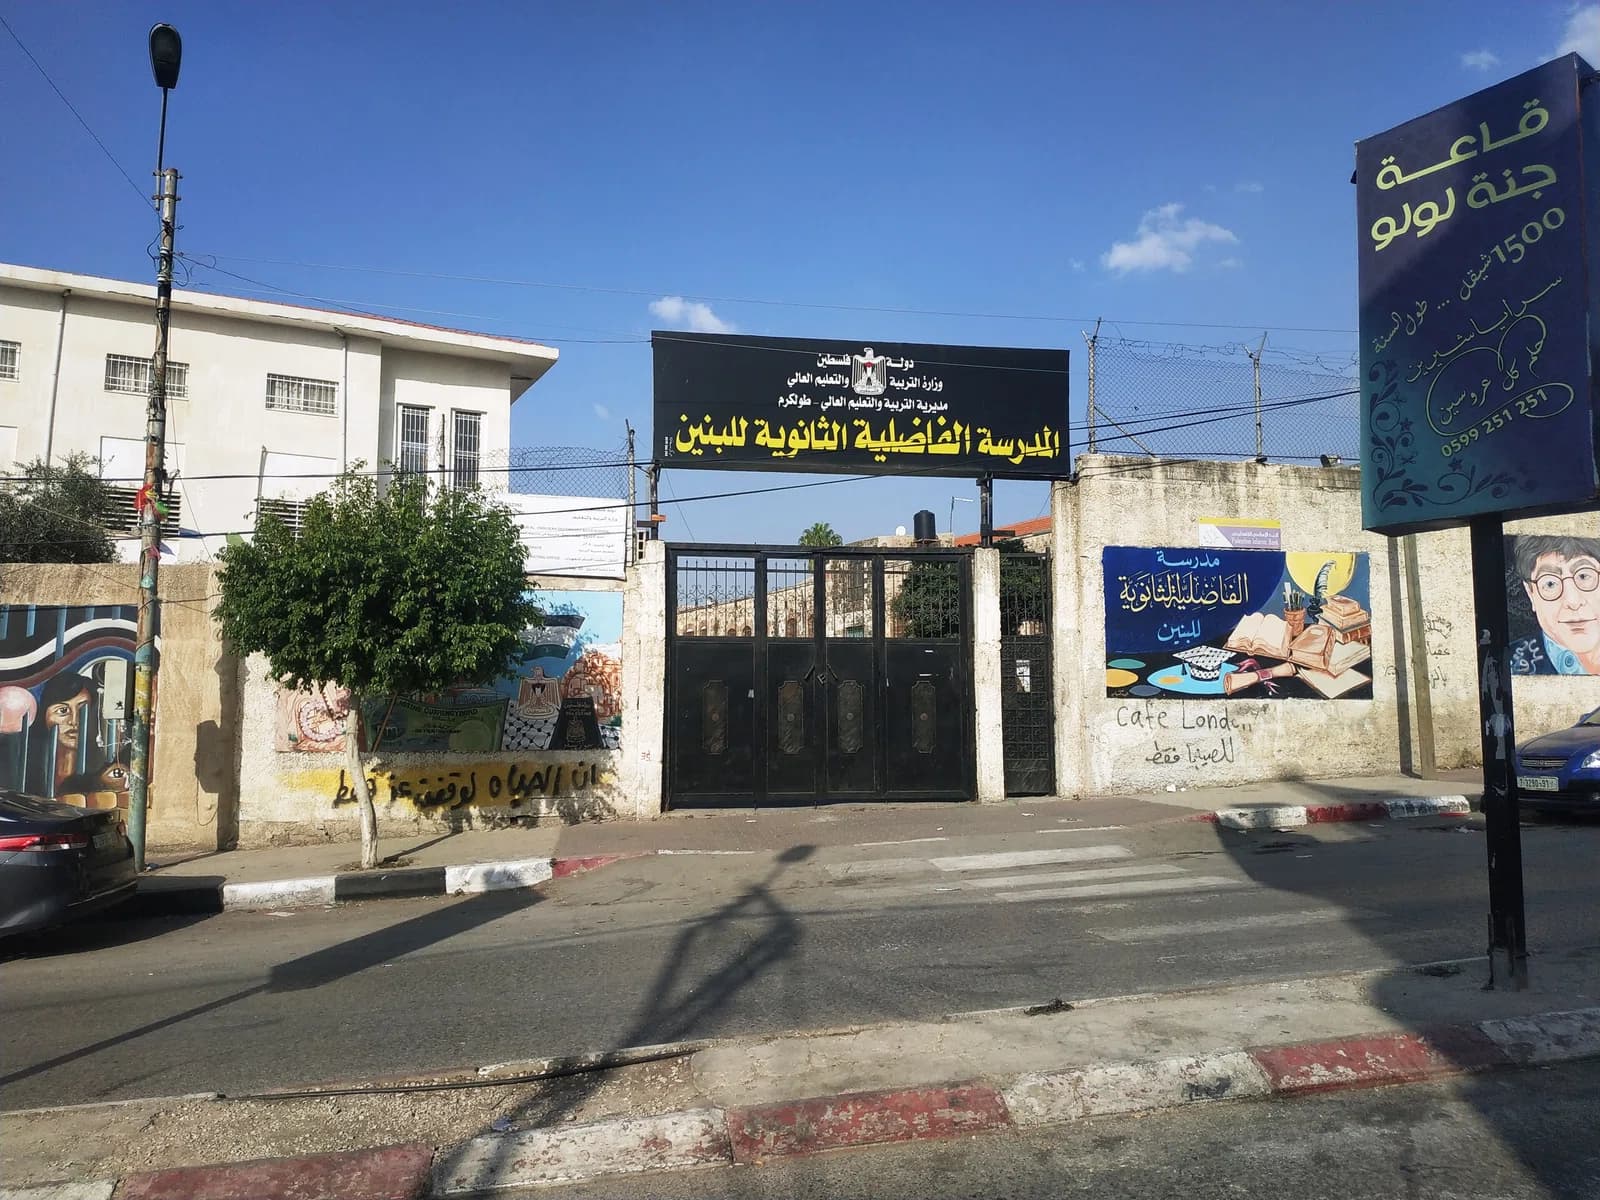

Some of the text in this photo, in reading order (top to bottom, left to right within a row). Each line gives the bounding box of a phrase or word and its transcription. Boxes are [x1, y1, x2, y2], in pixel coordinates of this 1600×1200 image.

[1376, 98, 1549, 191] قاعة
[1371, 163, 1557, 252] جنة لولو
[1490, 207, 1566, 264] 1500
[1459, 253, 1492, 301] شيقل
[1373, 311, 1402, 353] السنة
[1406, 299, 1427, 335] طول
[816, 353, 914, 371] دولة فلسطين
[1502, 358, 1520, 391] كل
[786, 371, 813, 387] العالي
[814, 373, 850, 388] والتعليم
[889, 376, 921, 390] التربية
[922, 375, 944, 391] وزارة
[777, 393, 812, 409] طولكرم
[820, 394, 847, 412] العالي
[848, 395, 883, 411] والتعليم
[884, 398, 915, 412] التربية
[916, 399, 949, 414] مديرية
[1440, 378, 1491, 425] عروسين
[675, 413, 749, 456] للبنين
[754, 415, 847, 459] الثانوية
[853, 414, 970, 463] الفاضلية
[1441, 388, 1549, 458] 0599 251 251
[976, 425, 1060, 465] المدرسة
[1156, 550, 1220, 569] مدرسة
[1157, 620, 1201, 645] للبنين
[1117, 700, 1169, 729] Cafe
[1145, 740, 1181, 765] فقط
[332, 769, 377, 809] فط
